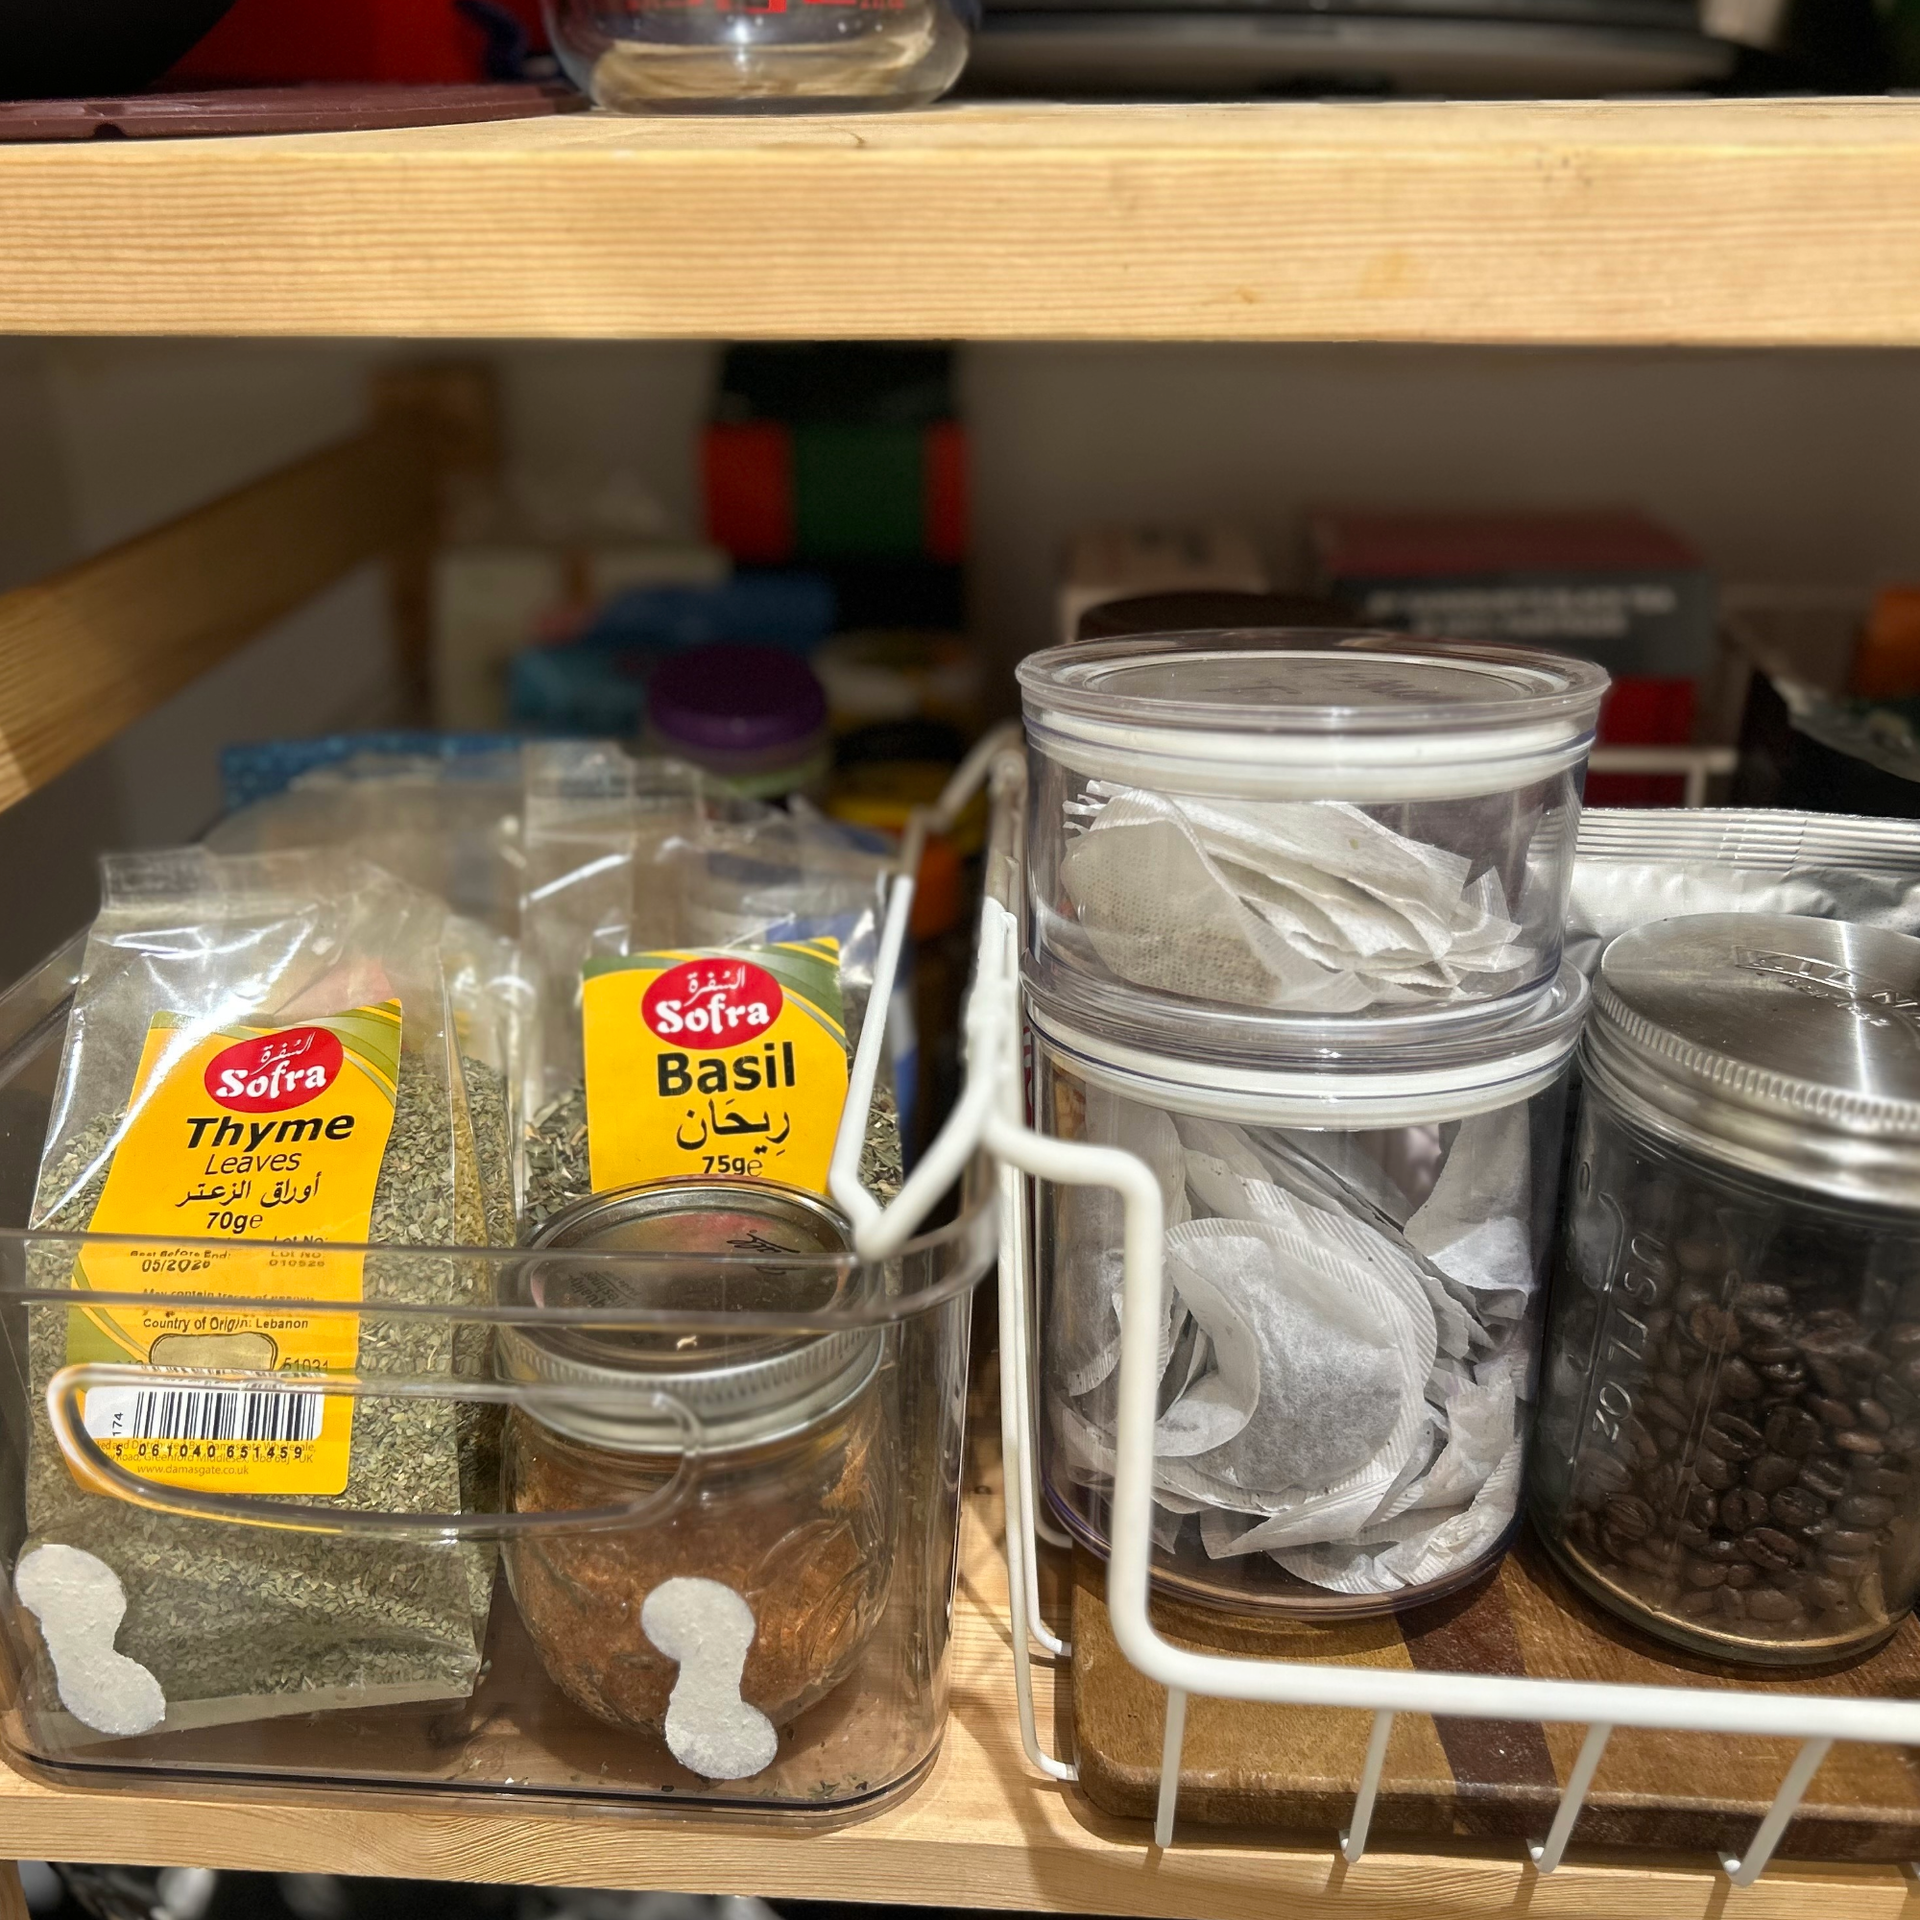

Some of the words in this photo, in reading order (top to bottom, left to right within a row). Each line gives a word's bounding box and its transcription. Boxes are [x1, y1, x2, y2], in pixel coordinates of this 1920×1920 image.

[655, 994, 770, 1034] Sofra
[215, 1059, 327, 1100] Sofra
[657, 1042, 796, 1097] Basil
[186, 1113, 355, 1153] Thyme
[204, 1151, 301, 1176] Leaves
[175, 1180, 252, 1208] الزعتر
[260, 1172, 321, 1208] أوراق
[143, 1317, 190, 1332] Country
[194, 1316, 207, 1329] of
[210, 1317, 252, 1332] Origin:
[256, 1318, 308, 1329] Lebanon
[112, 1412, 124, 1436] 174
[116, 1444, 122, 1457] 5
[137, 1464, 249, 1477] www.damasgate.co.uk
